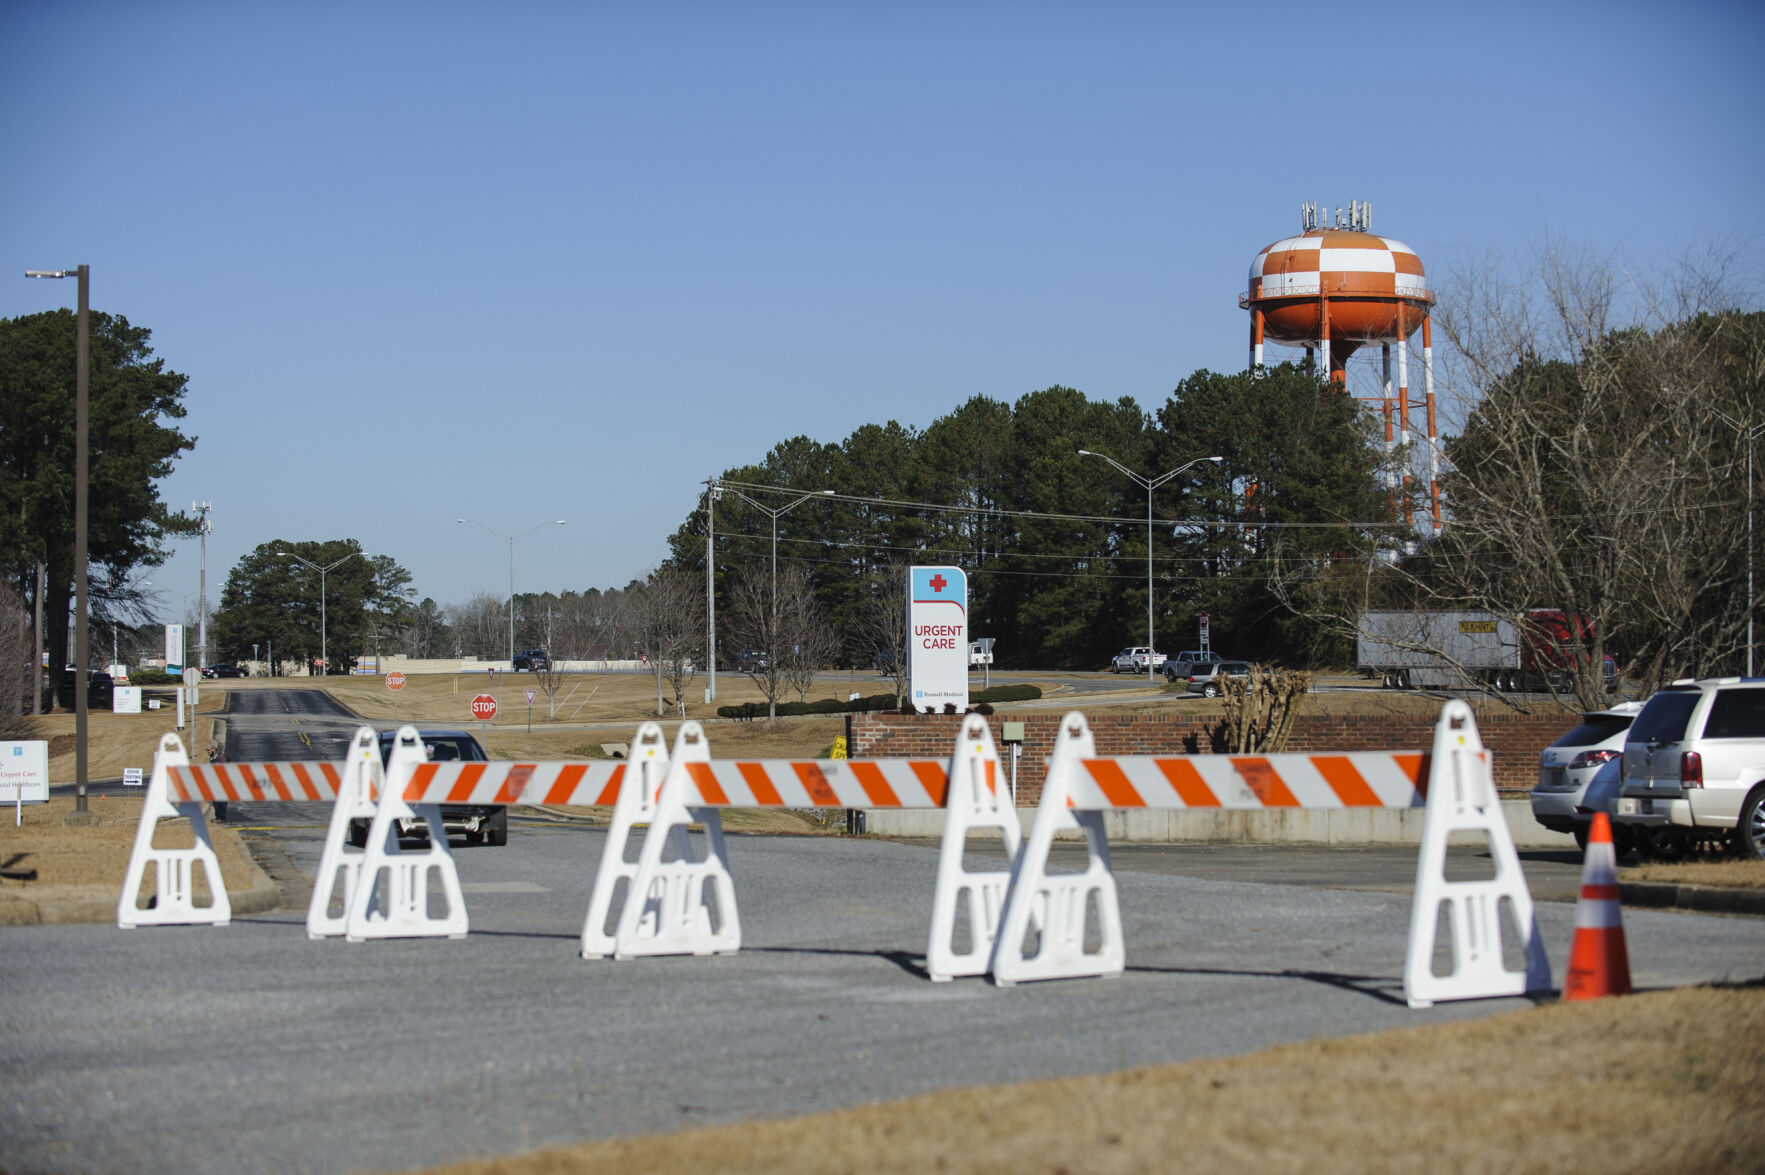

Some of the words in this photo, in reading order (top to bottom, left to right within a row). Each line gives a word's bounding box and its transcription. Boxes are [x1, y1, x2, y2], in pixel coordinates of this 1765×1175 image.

[914, 625, 963, 636] URGENT
[923, 638, 956, 649] CARE
[387, 677, 405, 685] STOP
[473, 702, 496, 712] STOP
